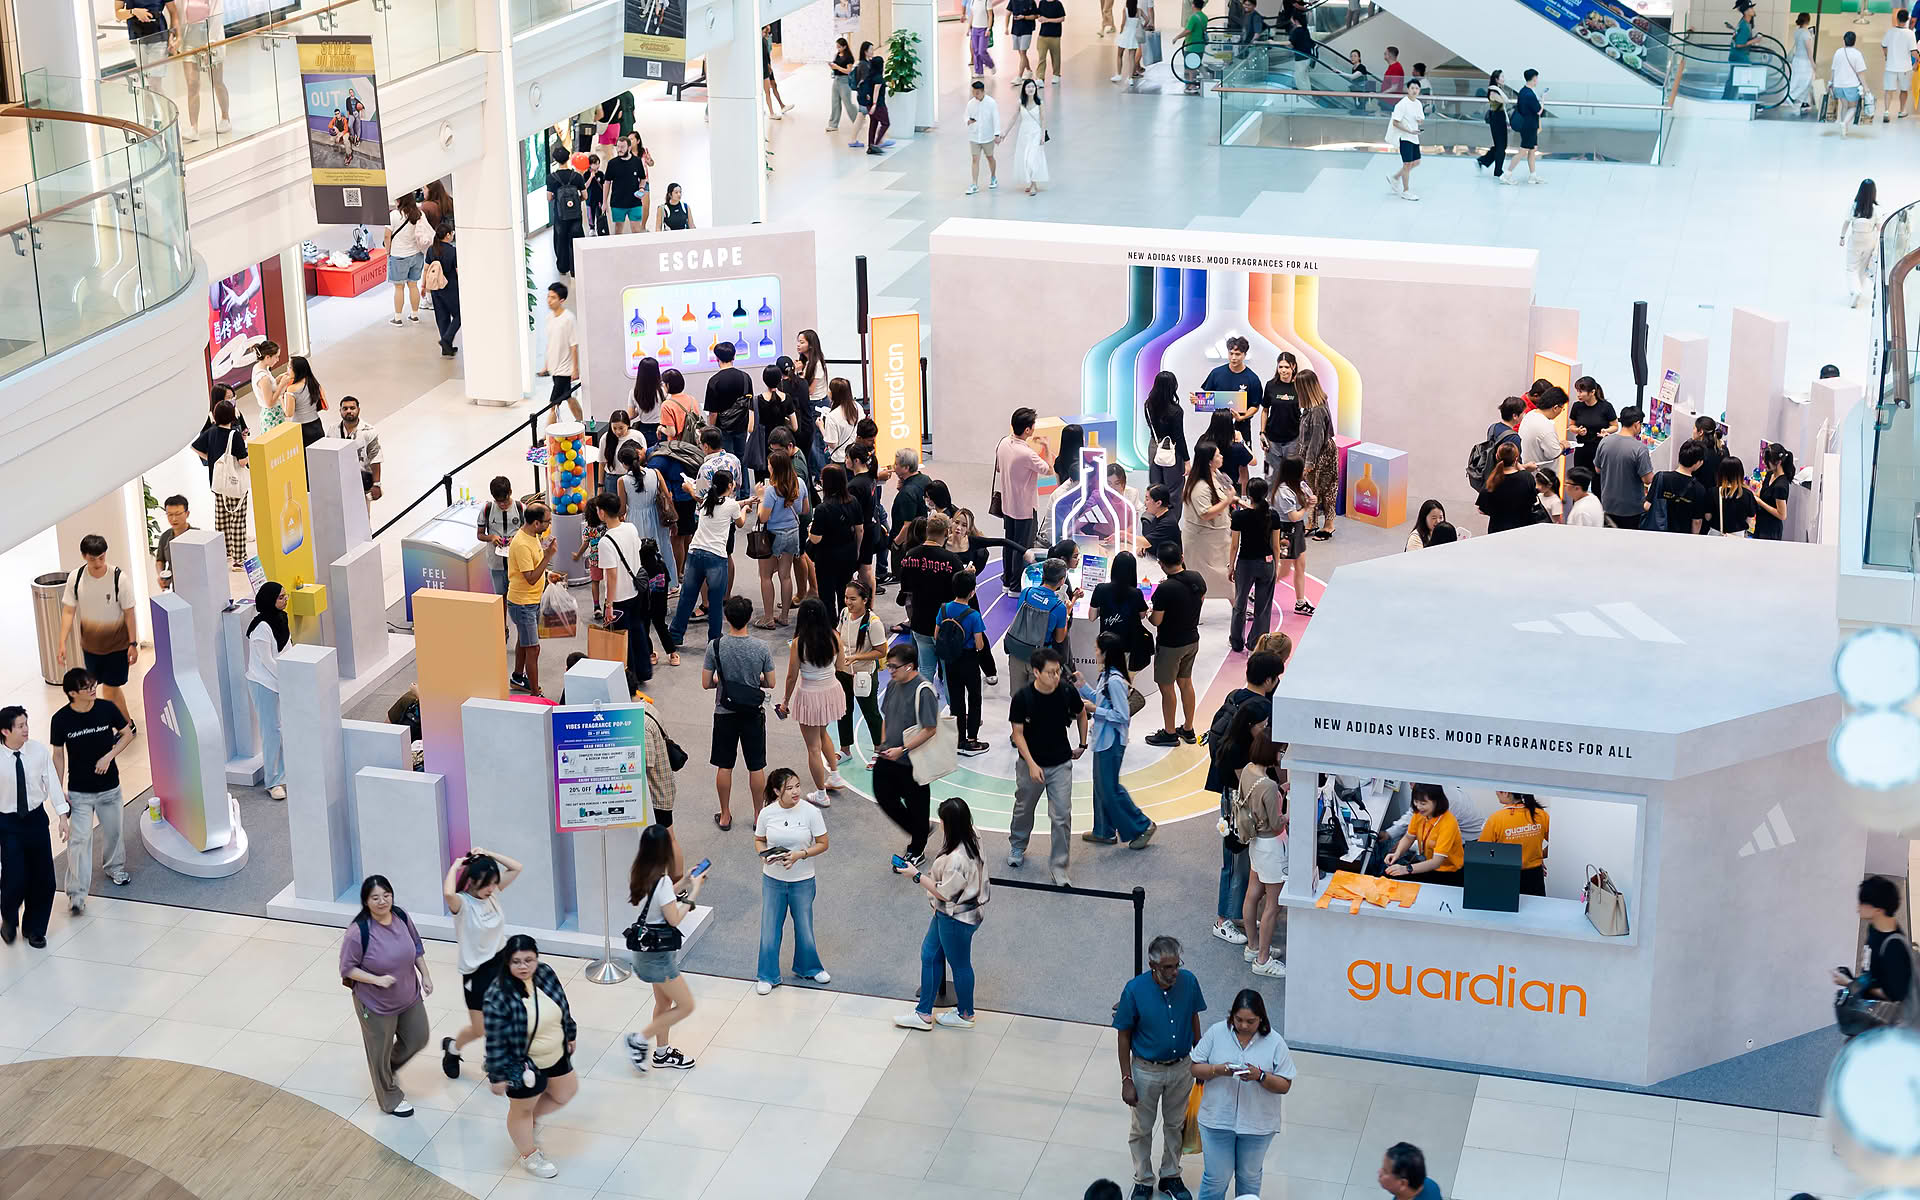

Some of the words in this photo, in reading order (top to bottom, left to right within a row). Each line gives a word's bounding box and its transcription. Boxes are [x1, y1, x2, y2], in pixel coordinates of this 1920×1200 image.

[311, 89, 341, 107] OUT
[658, 246, 743, 273] ESCAPE
[1127, 251, 1145, 261] NEW
[1147, 252, 1176, 262] ADIDAS
[1178, 254, 1205, 264] VIBES.
[1206, 256, 1229, 265] MOOD
[1231, 257, 1284, 268] FRAGRANCES
[1286, 260, 1302, 270] FOR
[1303, 261, 1320, 271] ALL
[360, 264, 387, 285] HUNTER
[883, 343, 910, 440] guardian
[422, 567, 447, 580] FEEL
[900, 556, 920, 569] alm
[921, 556, 953, 574] Angels
[425, 580, 445, 590] THE
[67, 730, 84, 739] Calvin
[1313, 717, 1342, 731] NEW
[1346, 720, 1394, 736] ADIDAS
[1398, 725, 1440, 741] VIBES.
[1445, 729, 1483, 745] MOOD
[1487, 734, 1574, 754] FRAGRANCES
[1578, 742, 1604, 756] FOR
[1608, 745, 1633, 759] ALL
[1504, 823, 1542, 837] guardian
[1347, 959, 1587, 1017] guardian
